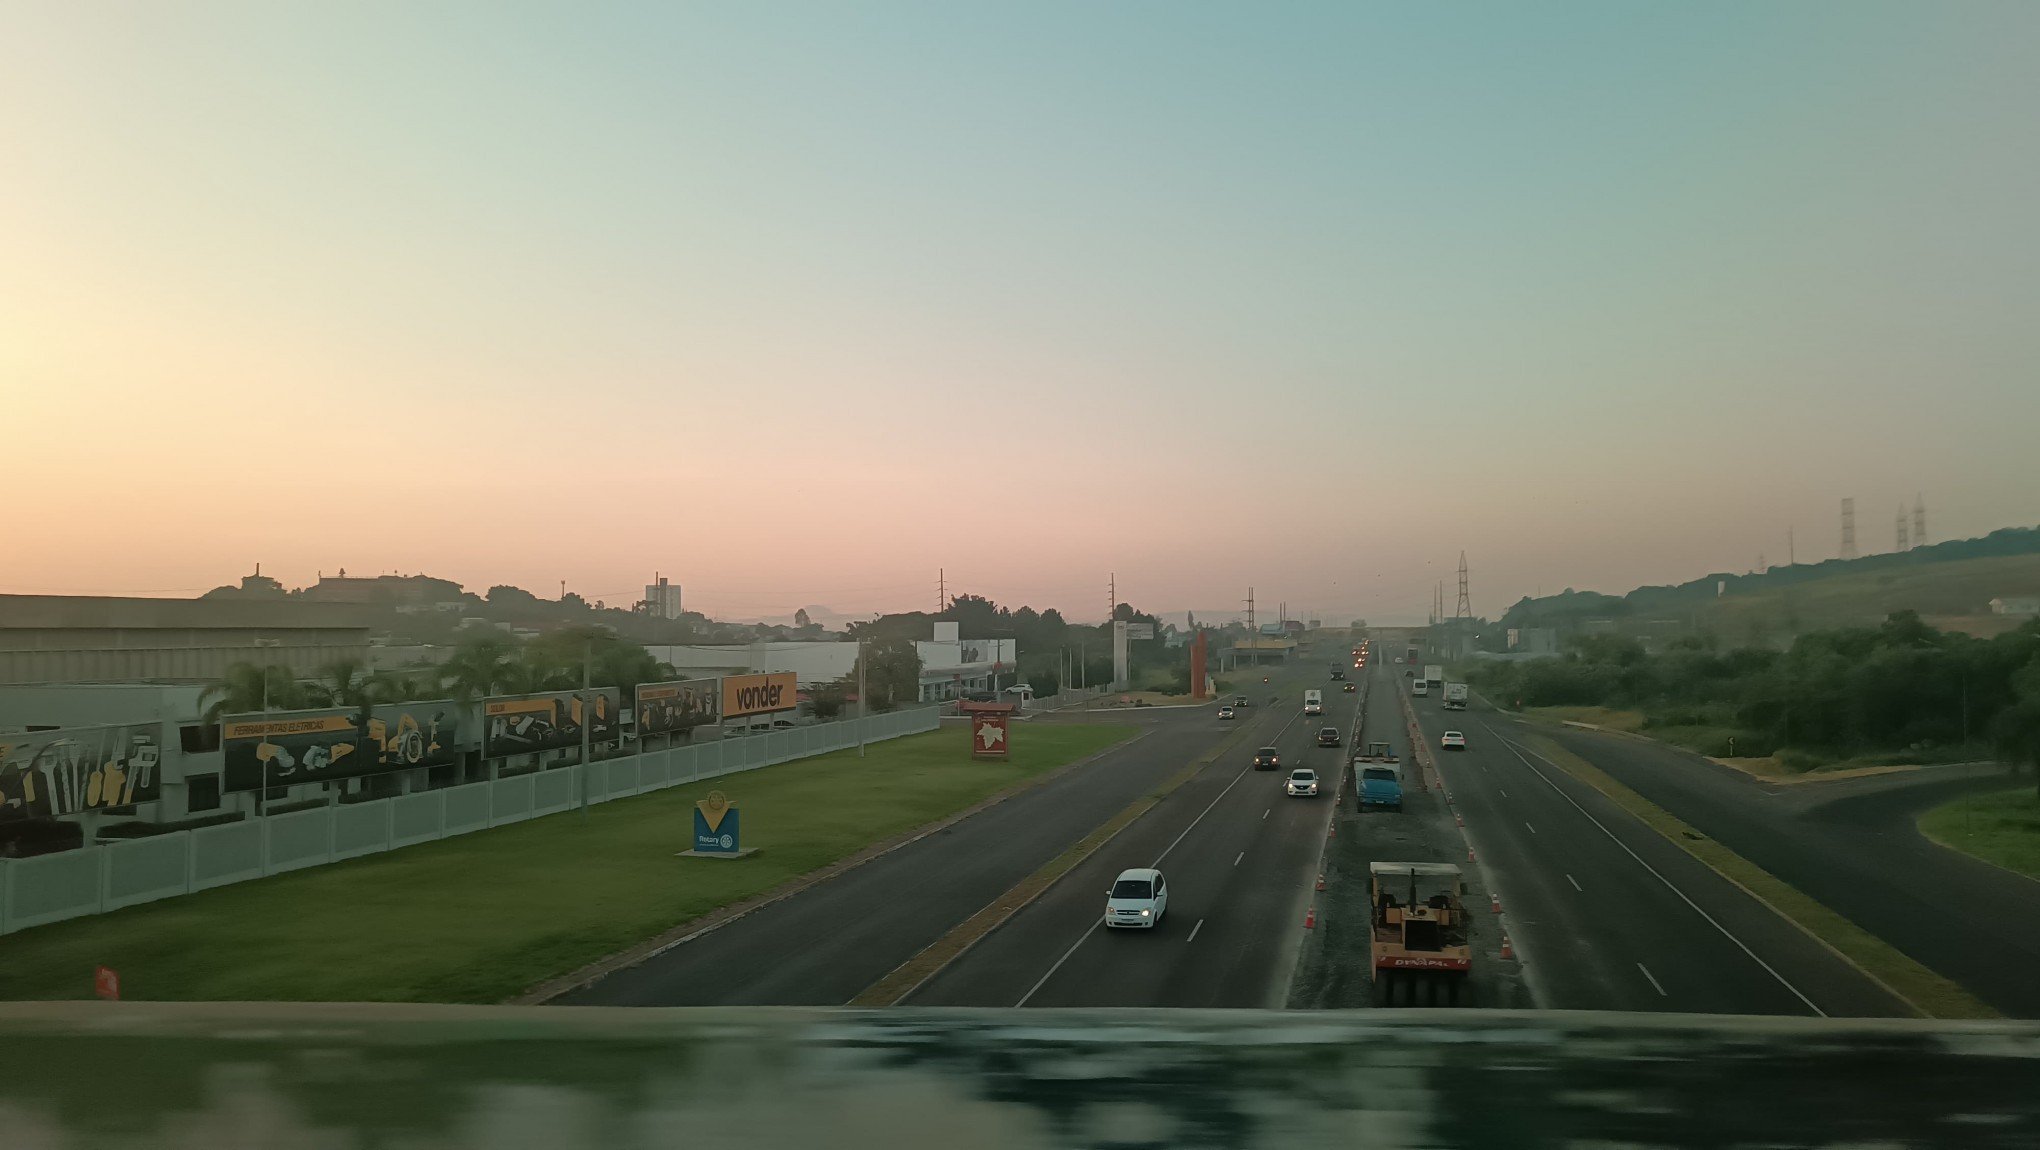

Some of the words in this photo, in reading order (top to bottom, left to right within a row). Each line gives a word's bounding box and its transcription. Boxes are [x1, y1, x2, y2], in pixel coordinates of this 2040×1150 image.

[737, 676, 783, 711] vonder
[233, 723, 287, 736] FERRAMENTAS
[699, 835, 719, 844] Rotary
